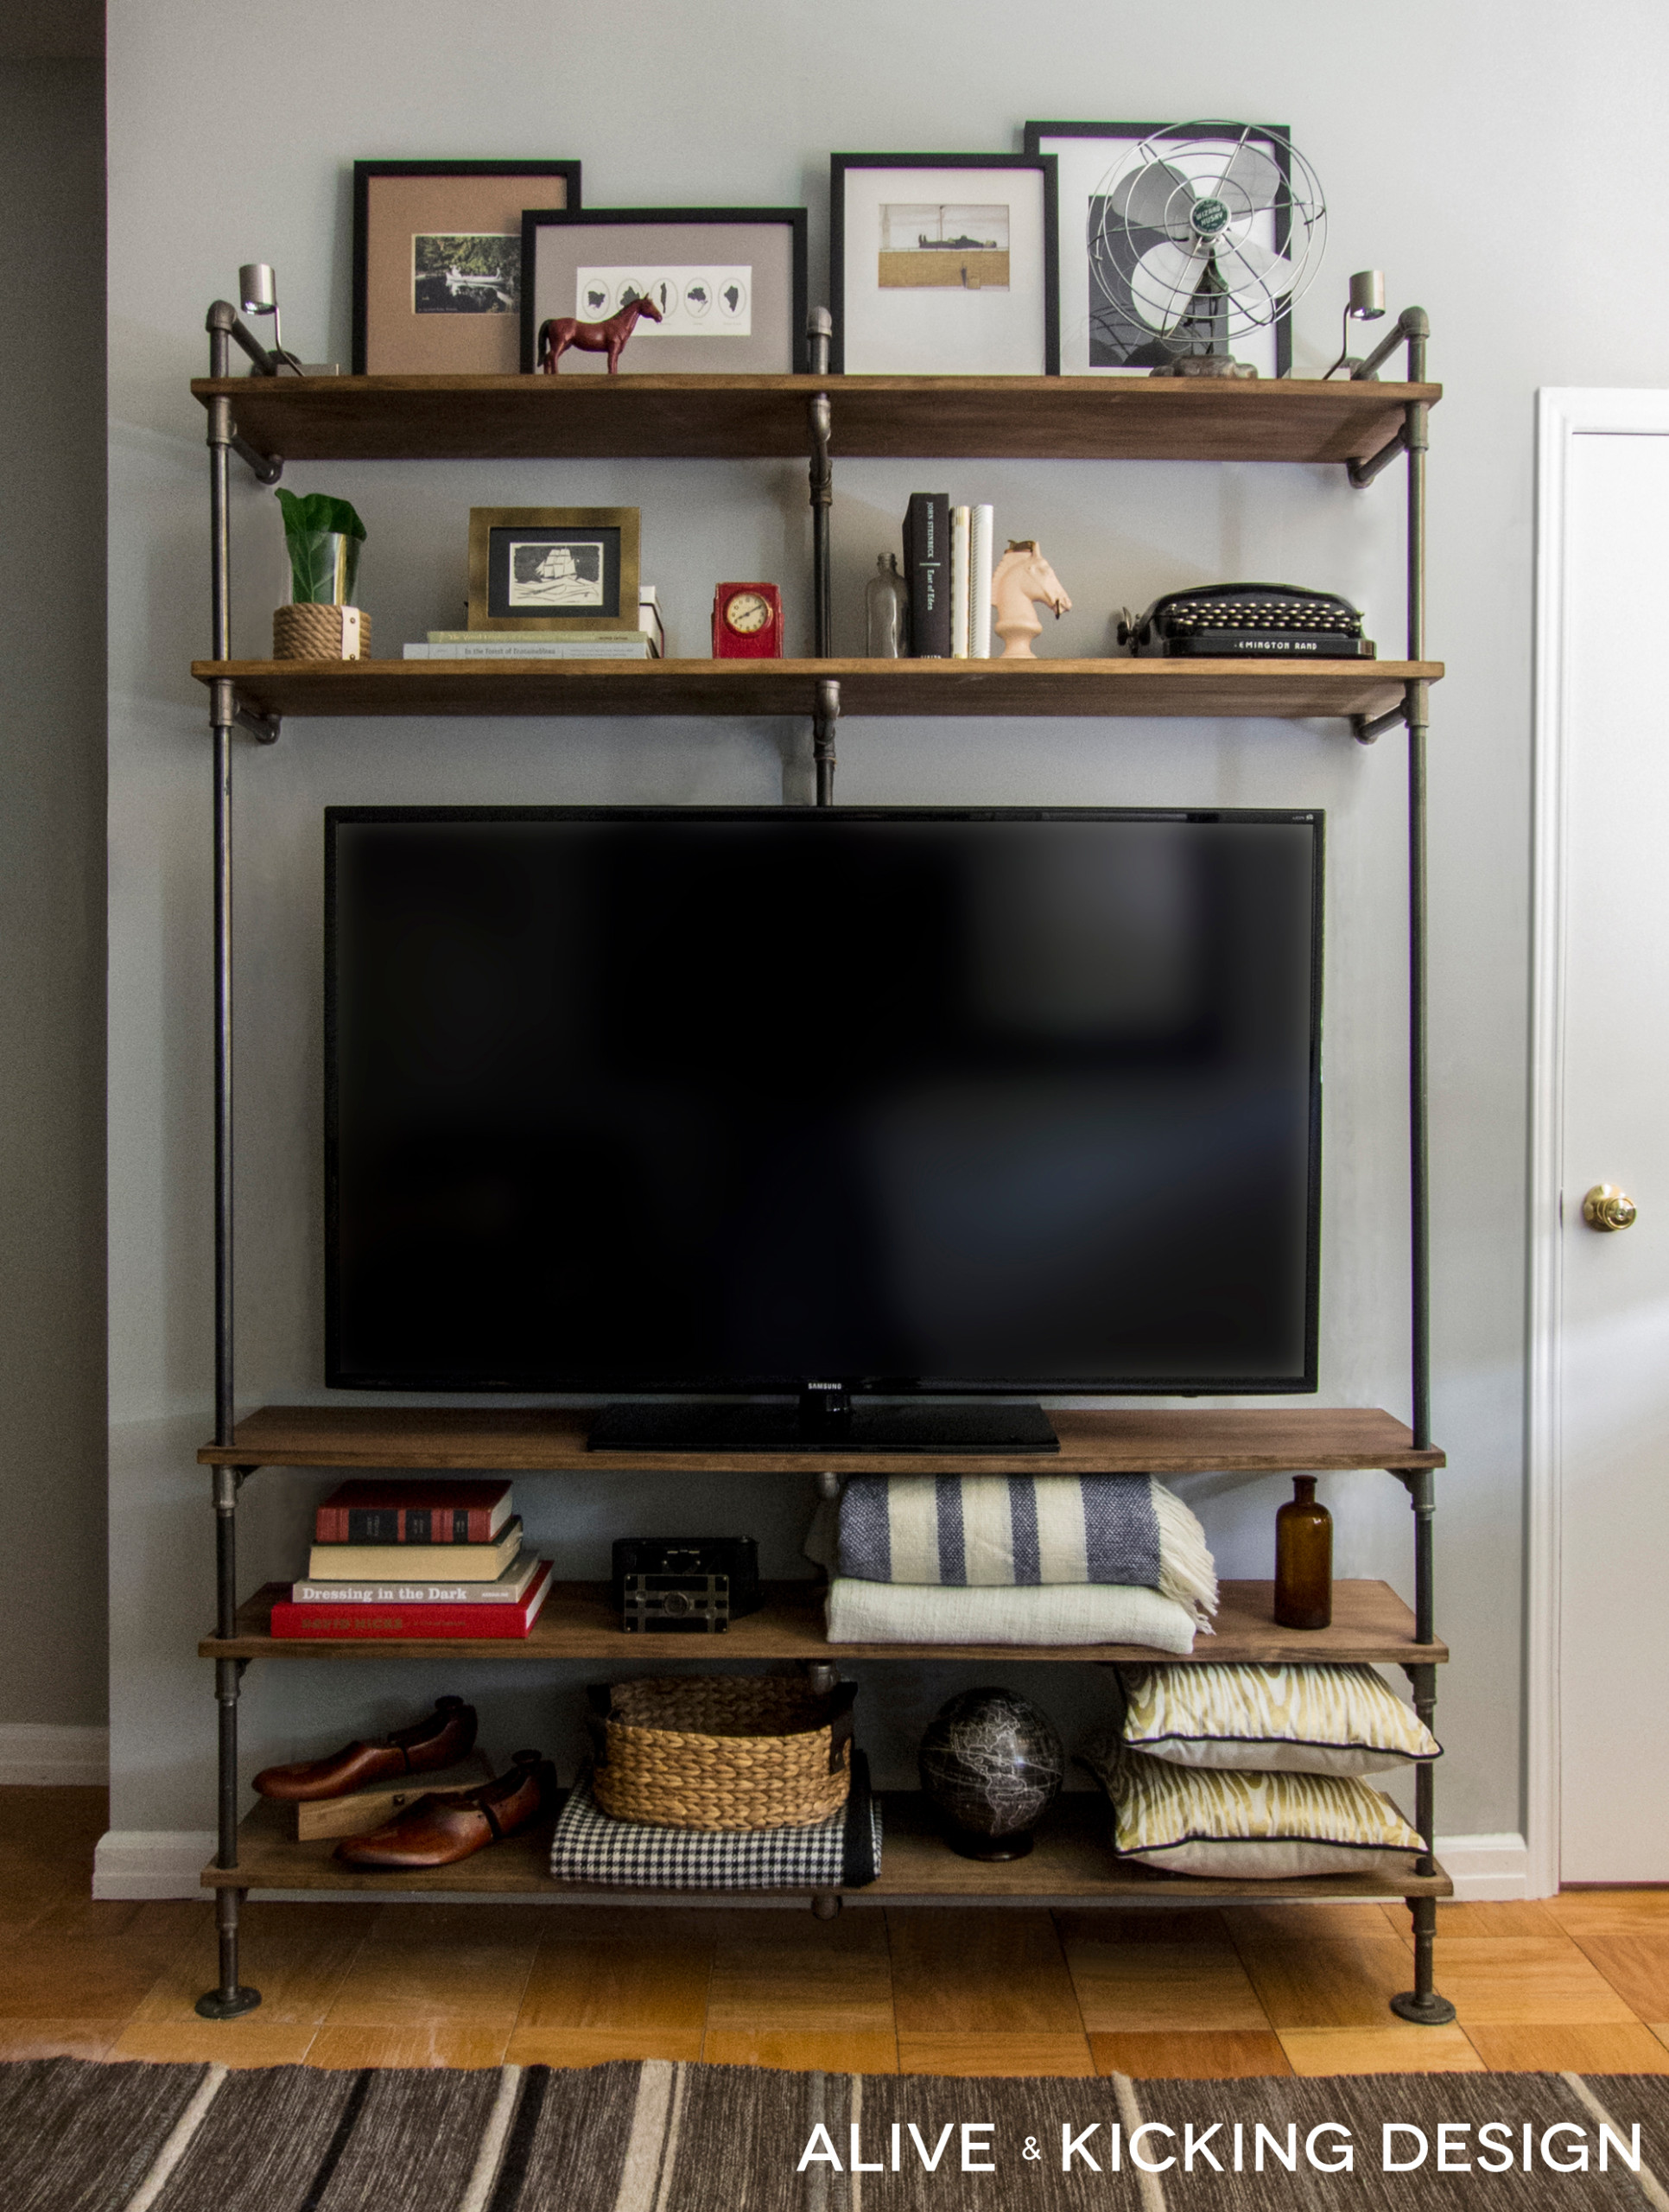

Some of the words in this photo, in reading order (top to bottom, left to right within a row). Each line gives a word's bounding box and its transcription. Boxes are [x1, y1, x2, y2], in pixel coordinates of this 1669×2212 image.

[1234, 641, 1290, 650] EMINGTON
[1294, 642, 1317, 651] RAND
[301, 1587, 373, 1603] Dressing
[378, 1587, 394, 1600] in
[398, 1587, 424, 1600] the
[428, 1587, 467, 1600] Dark
